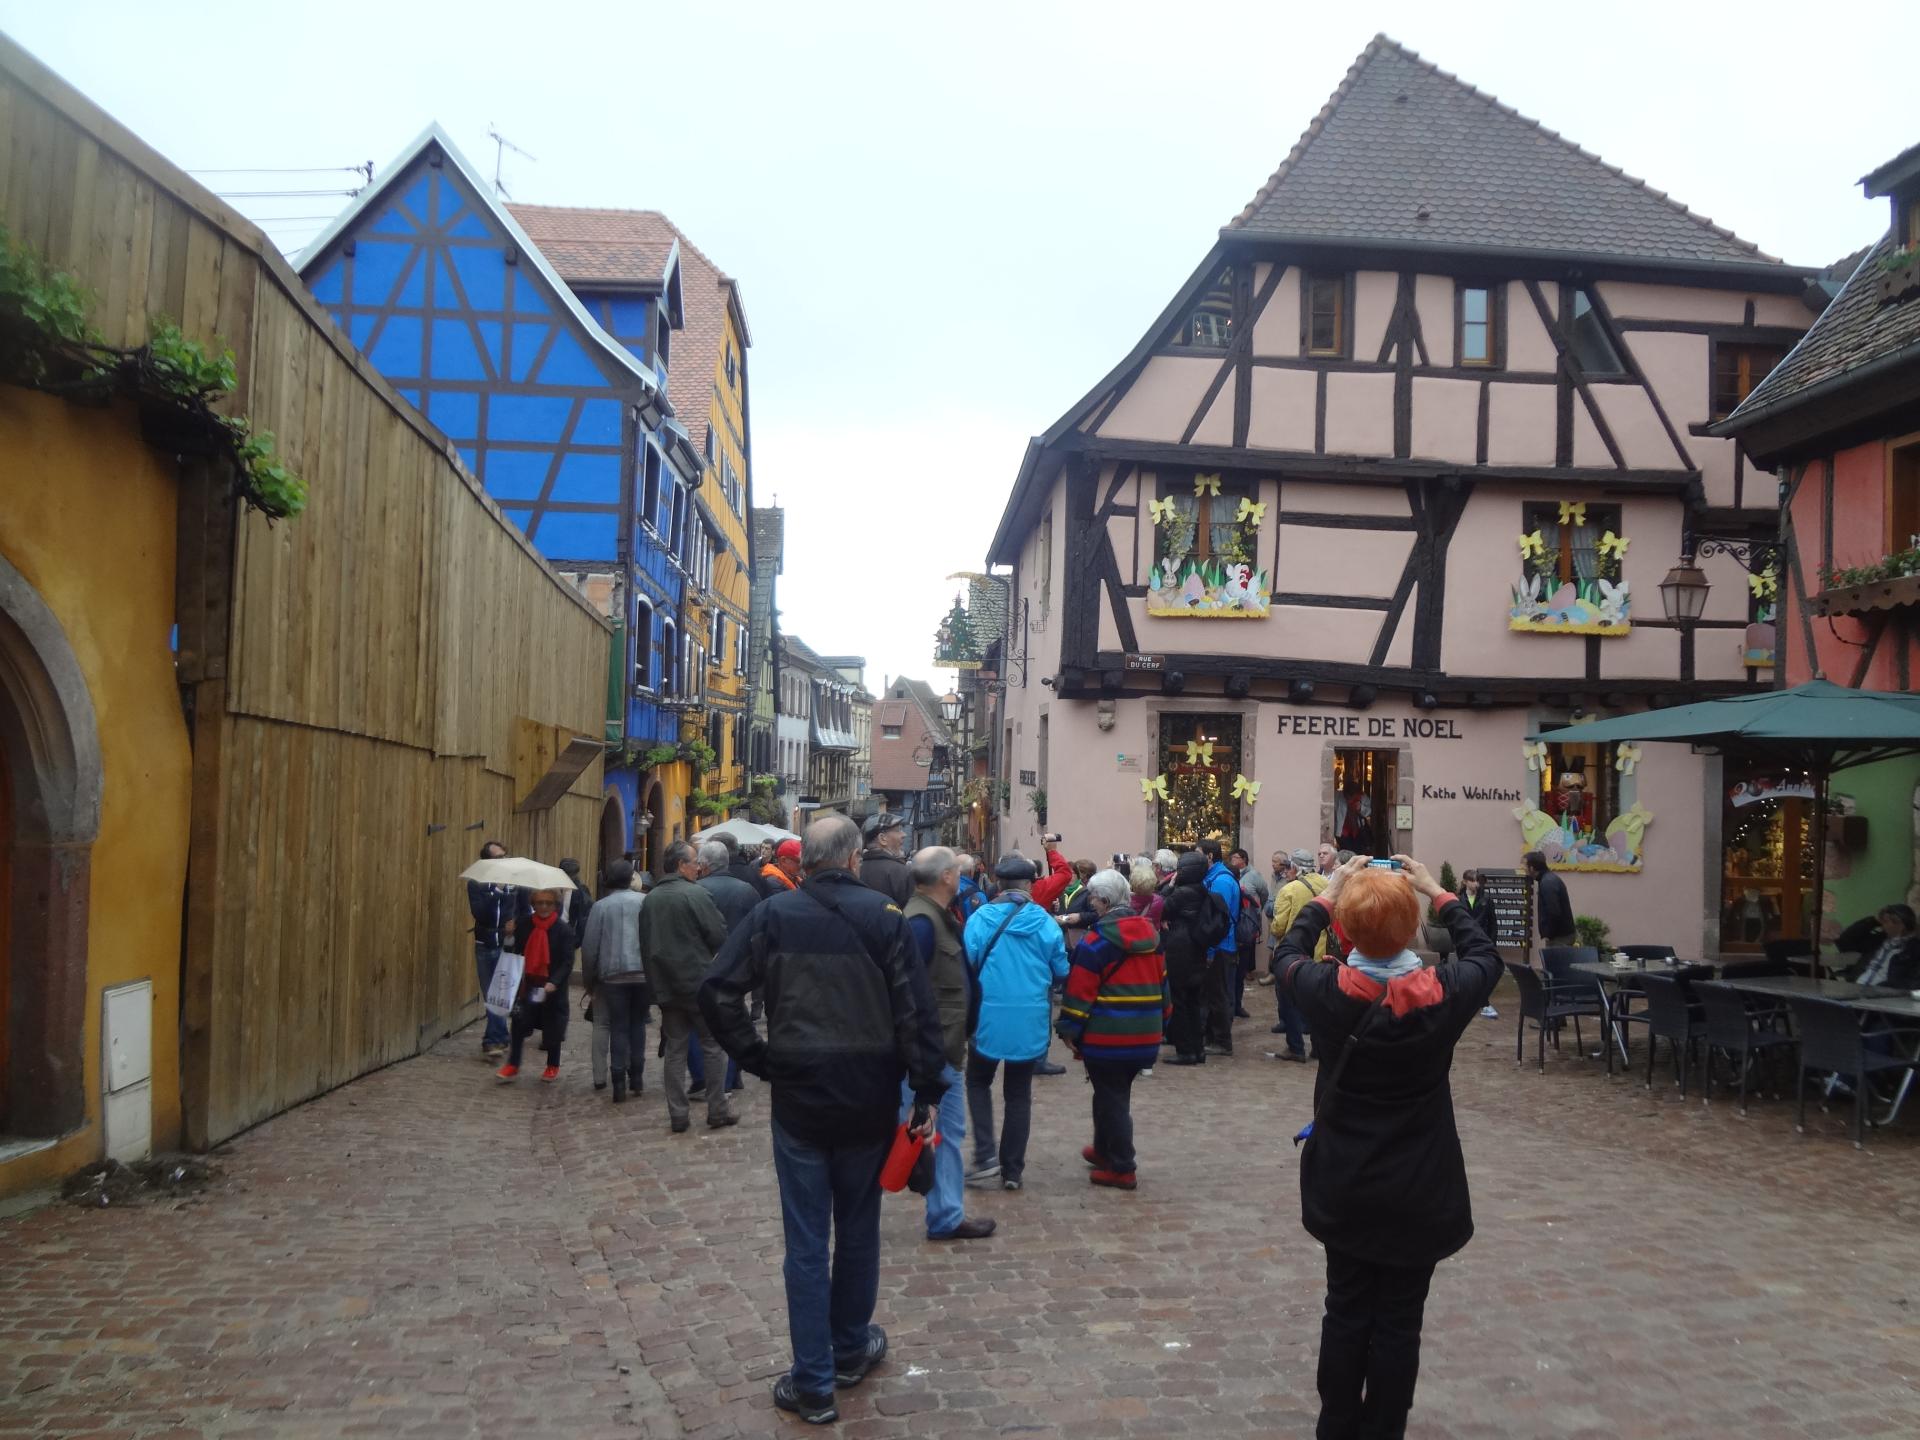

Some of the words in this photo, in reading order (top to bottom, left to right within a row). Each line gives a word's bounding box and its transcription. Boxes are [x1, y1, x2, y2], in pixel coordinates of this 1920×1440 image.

[1277, 714, 1360, 736] FEERIE
[1368, 717, 1396, 737] DE
[1402, 718, 1463, 739] NOEL
[1422, 784, 1456, 799] Kathe
[1462, 785, 1521, 801] Wohlfahrt
